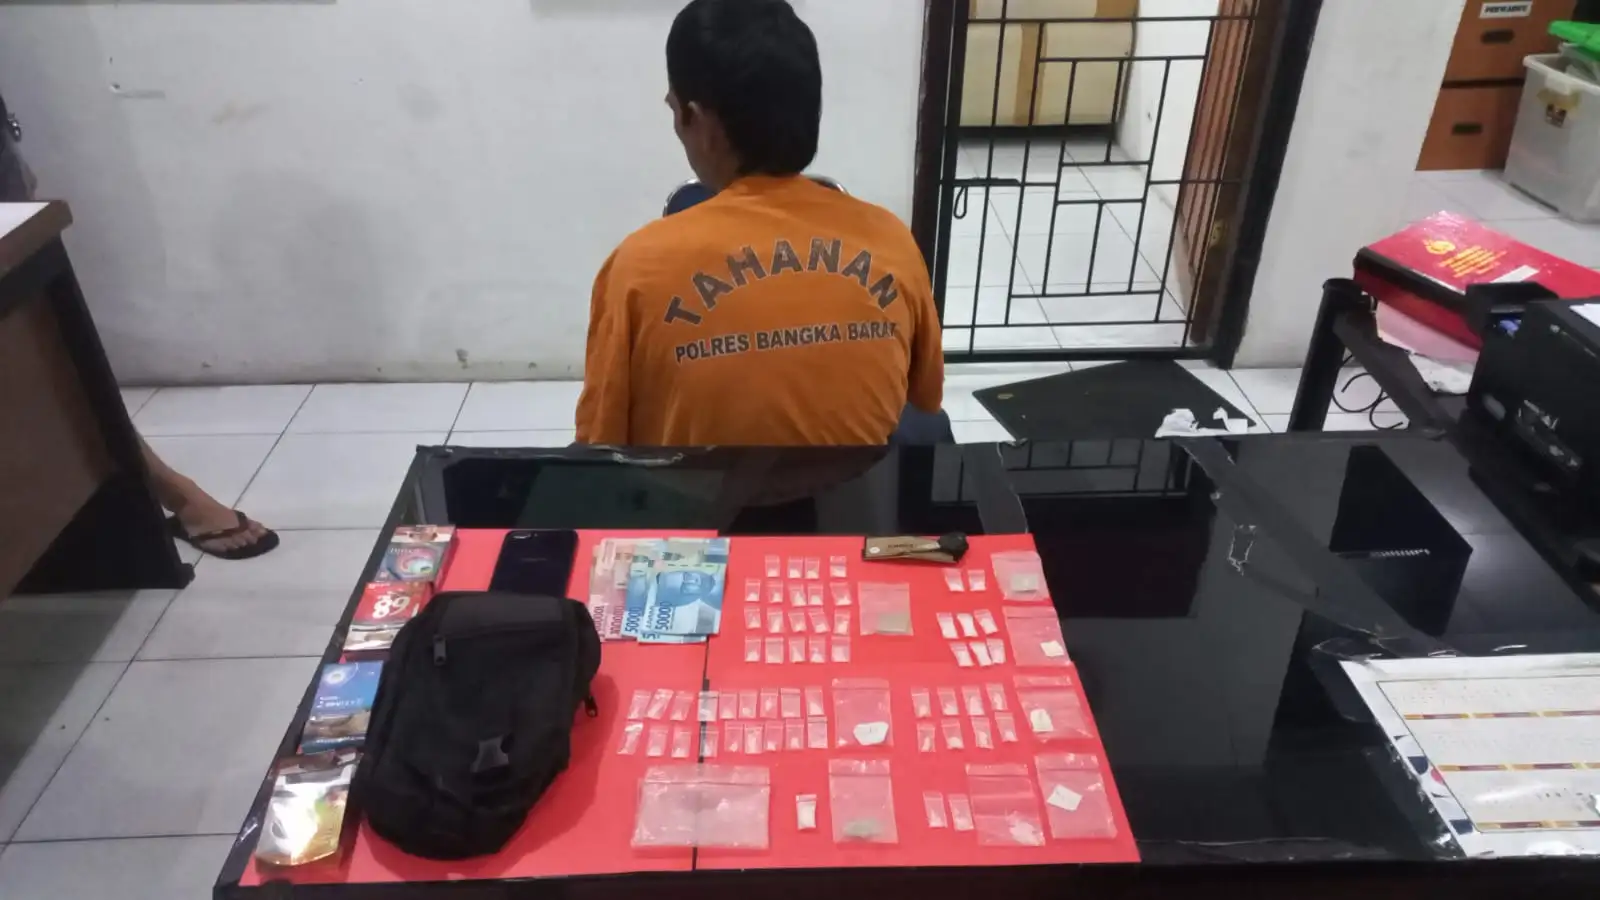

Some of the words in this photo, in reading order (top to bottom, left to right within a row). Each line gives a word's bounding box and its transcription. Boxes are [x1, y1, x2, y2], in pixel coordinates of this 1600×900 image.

[664, 237, 898, 325] TAHANAN
[675, 335, 749, 362] POLRES
[756, 324, 841, 349] BANGKA
[847, 321, 897, 341] BARAT
[625, 606, 642, 634] 50000
[655, 602, 672, 631] 50000
